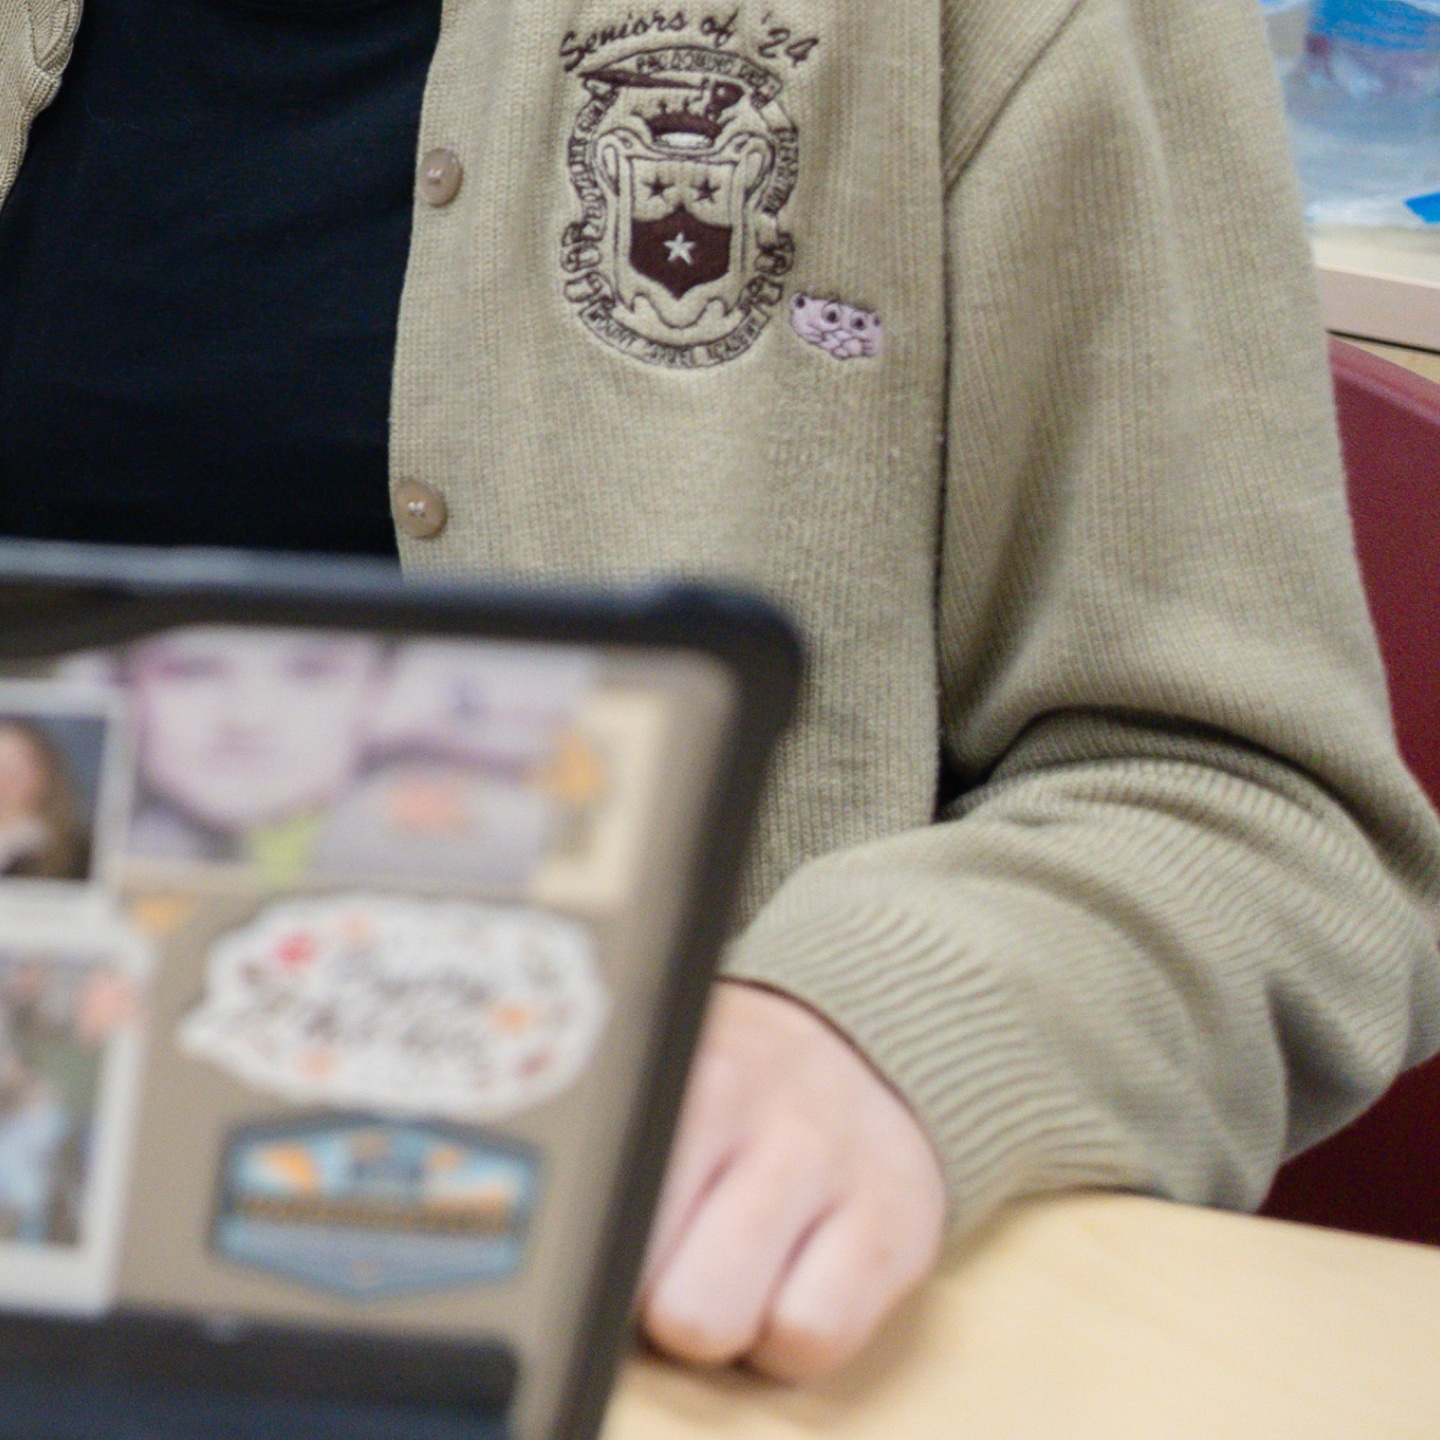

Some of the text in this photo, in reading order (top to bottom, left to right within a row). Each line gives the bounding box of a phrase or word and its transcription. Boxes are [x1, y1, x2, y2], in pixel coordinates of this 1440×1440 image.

[558, 11, 688, 72] Seniors
[700, 7, 740, 48] of
[758, 11, 820, 68] '24
